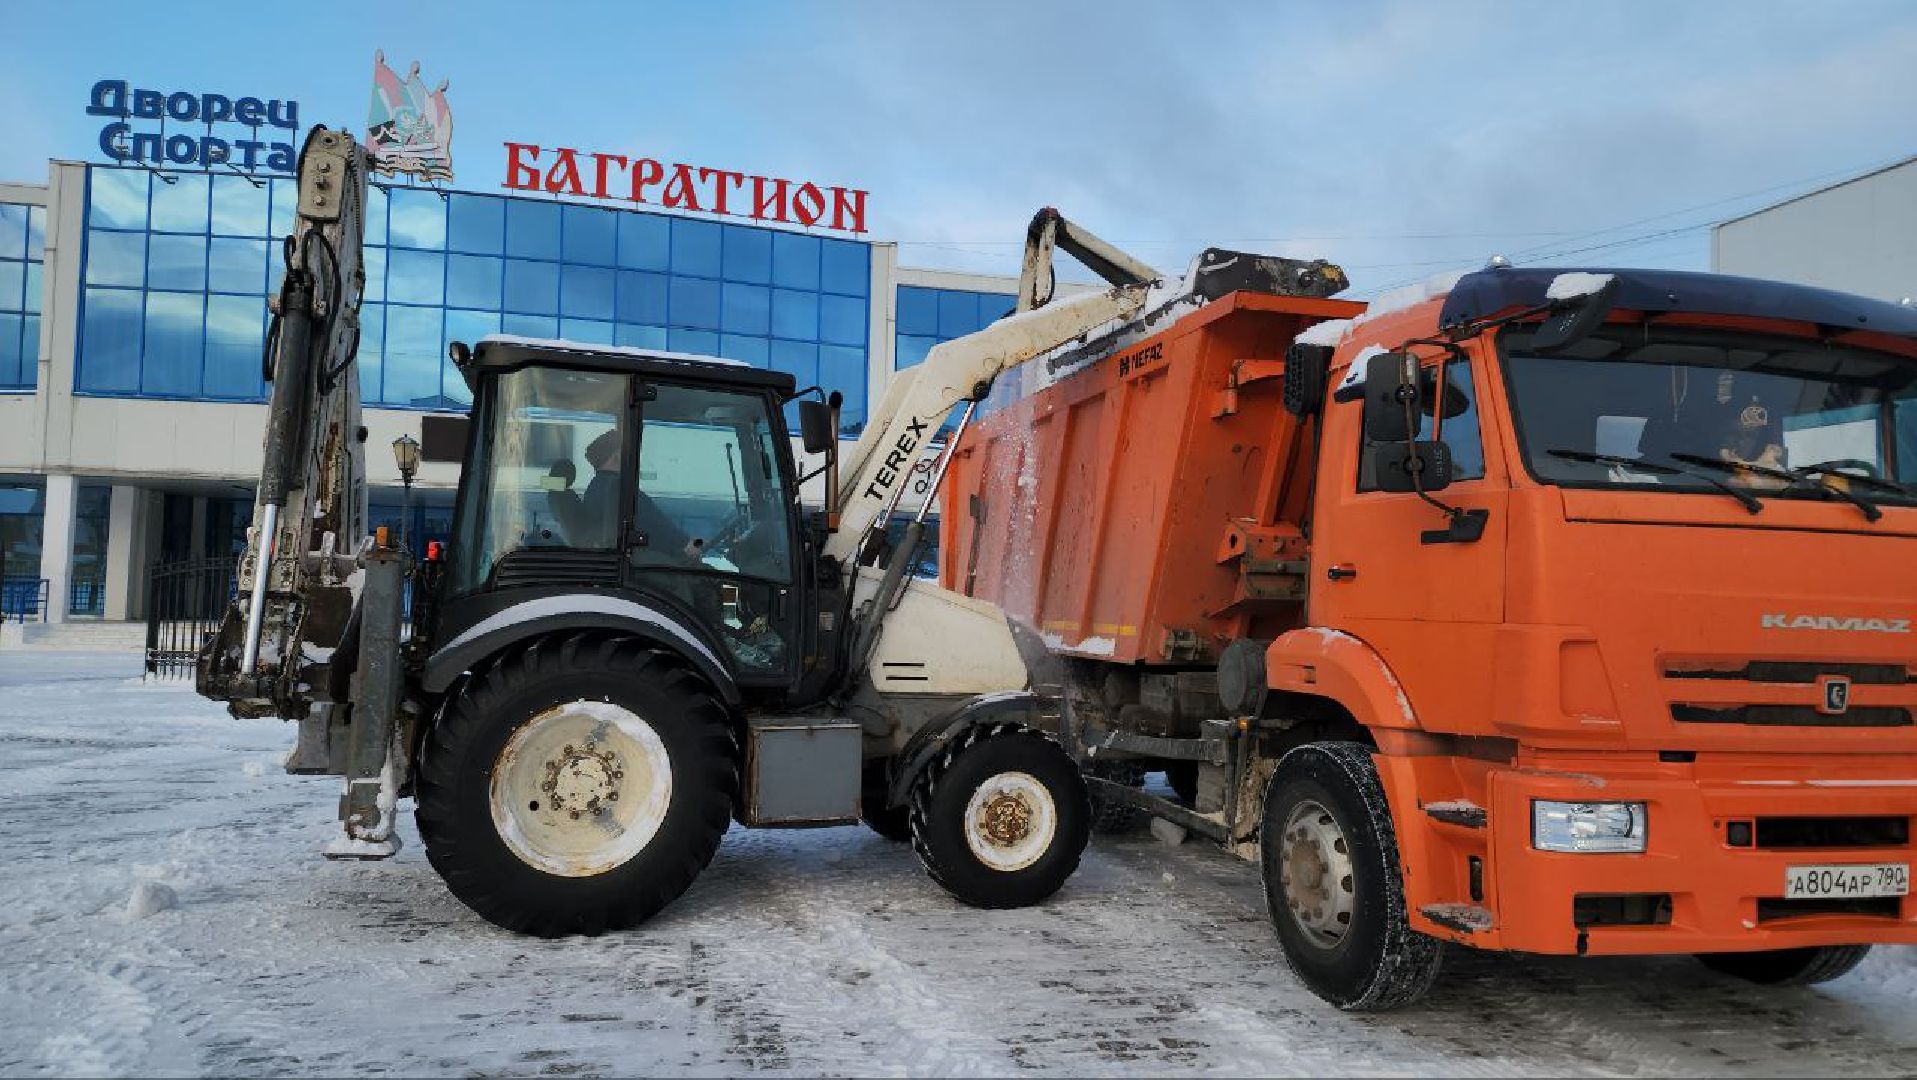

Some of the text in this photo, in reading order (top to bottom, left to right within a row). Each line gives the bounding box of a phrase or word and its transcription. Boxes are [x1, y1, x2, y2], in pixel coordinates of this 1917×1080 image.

[87, 79, 298, 129] Дворец
[99, 122, 297, 172] Спорта
[864, 416, 928, 500] TEREX
[1761, 614, 1912, 633] KAMAZ
